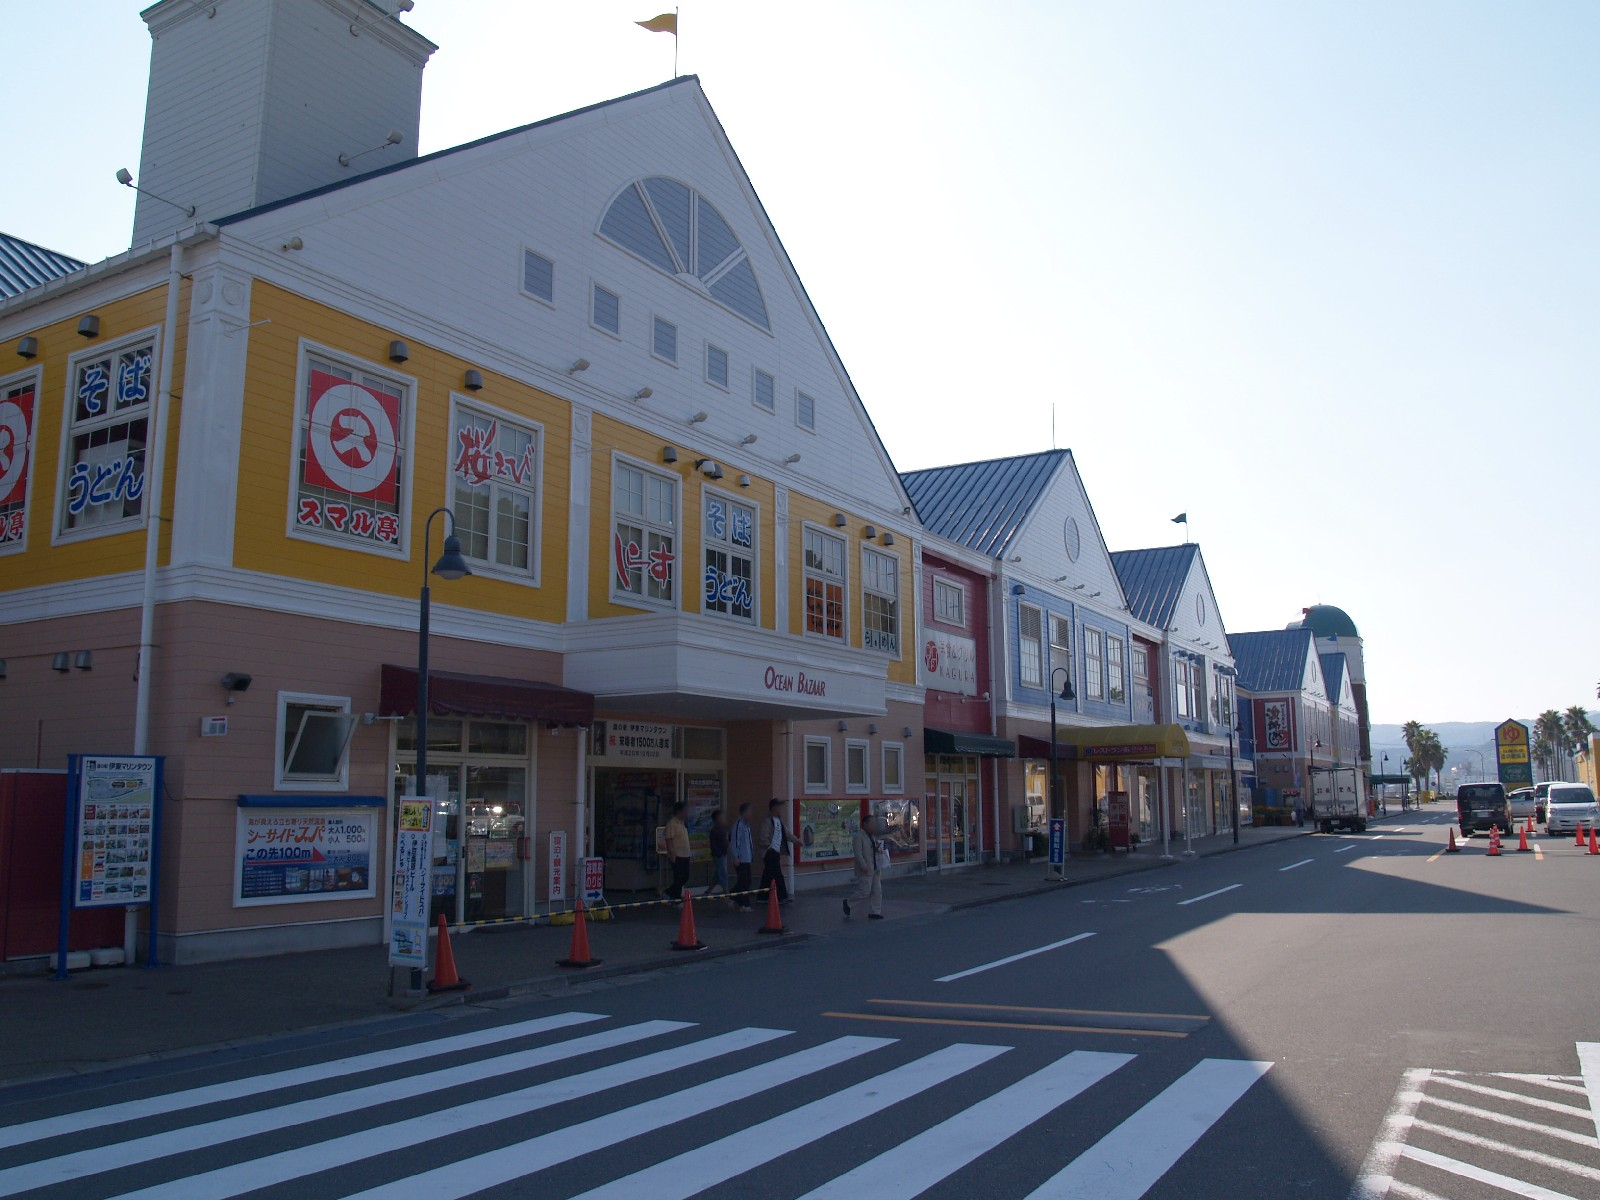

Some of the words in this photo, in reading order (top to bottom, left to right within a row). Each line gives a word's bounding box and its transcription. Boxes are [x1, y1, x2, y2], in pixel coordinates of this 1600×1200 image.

[79, 354, 152, 413] そば
[455, 420, 535, 485] 桜えび
[69, 457, 144, 514] うどん
[299, 498, 399, 542] スマル亭
[707, 502, 752, 546] そば
[705, 565, 752, 610] うどん
[764, 666, 794, 692] OCEAN
[797, 671, 826, 697] BAZAAR
[939, 665, 975, 684] KAGURA
[247, 825, 326, 844] シーサイドスパ
[328, 826, 340, 834] 大人
[246, 847, 311, 861] この先100m
